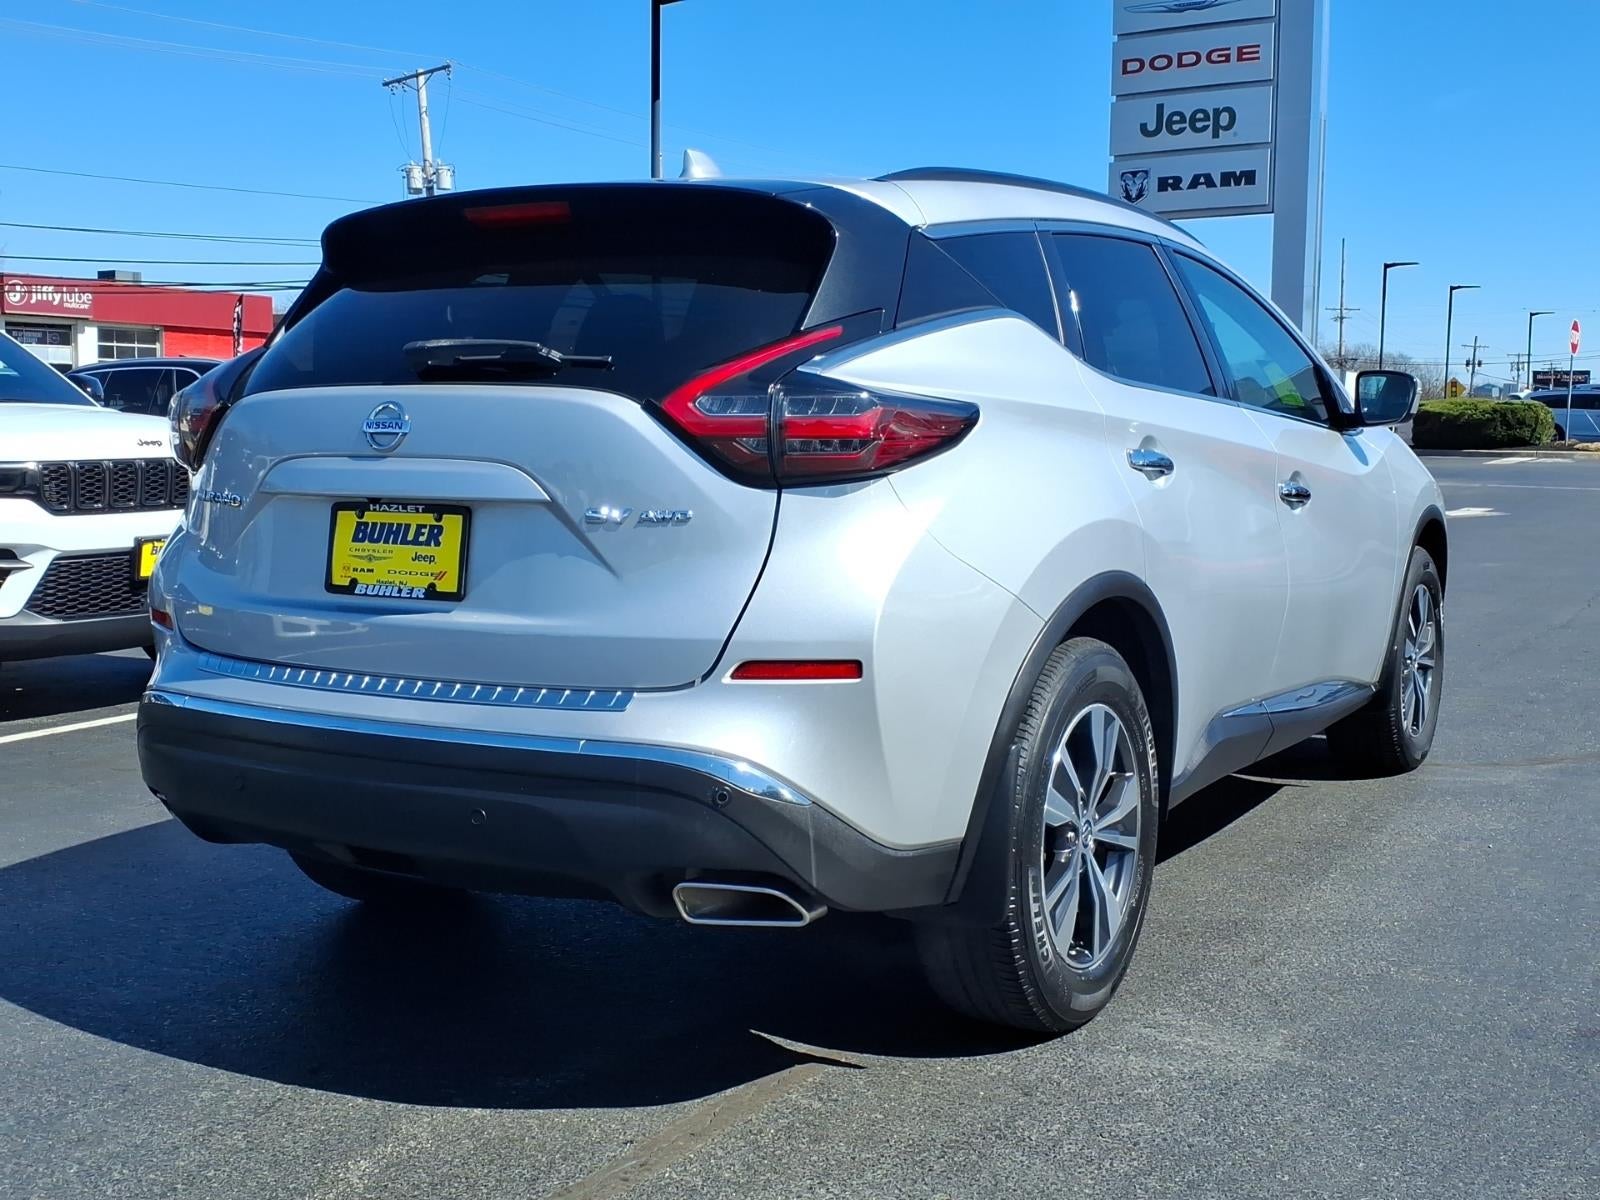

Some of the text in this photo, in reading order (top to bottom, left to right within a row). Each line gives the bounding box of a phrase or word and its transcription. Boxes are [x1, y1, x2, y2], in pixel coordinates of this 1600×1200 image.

[1121, 44, 1261, 76] DODGE
[1139, 103, 1237, 139] Jeep
[1156, 169, 1257, 193] RAM
[30, 285, 93, 305] jiffy lube
[365, 421, 404, 430] NISSAN
[136, 438, 163, 447] Jeep
[369, 503, 426, 513] HAZLET
[351, 520, 444, 547] BUHLER
[411, 551, 436, 564] Jeep
[387, 569, 438, 577] DODGE
[354, 583, 426, 599] BUHLER
[1031, 875, 1053, 973] ICHELIN
